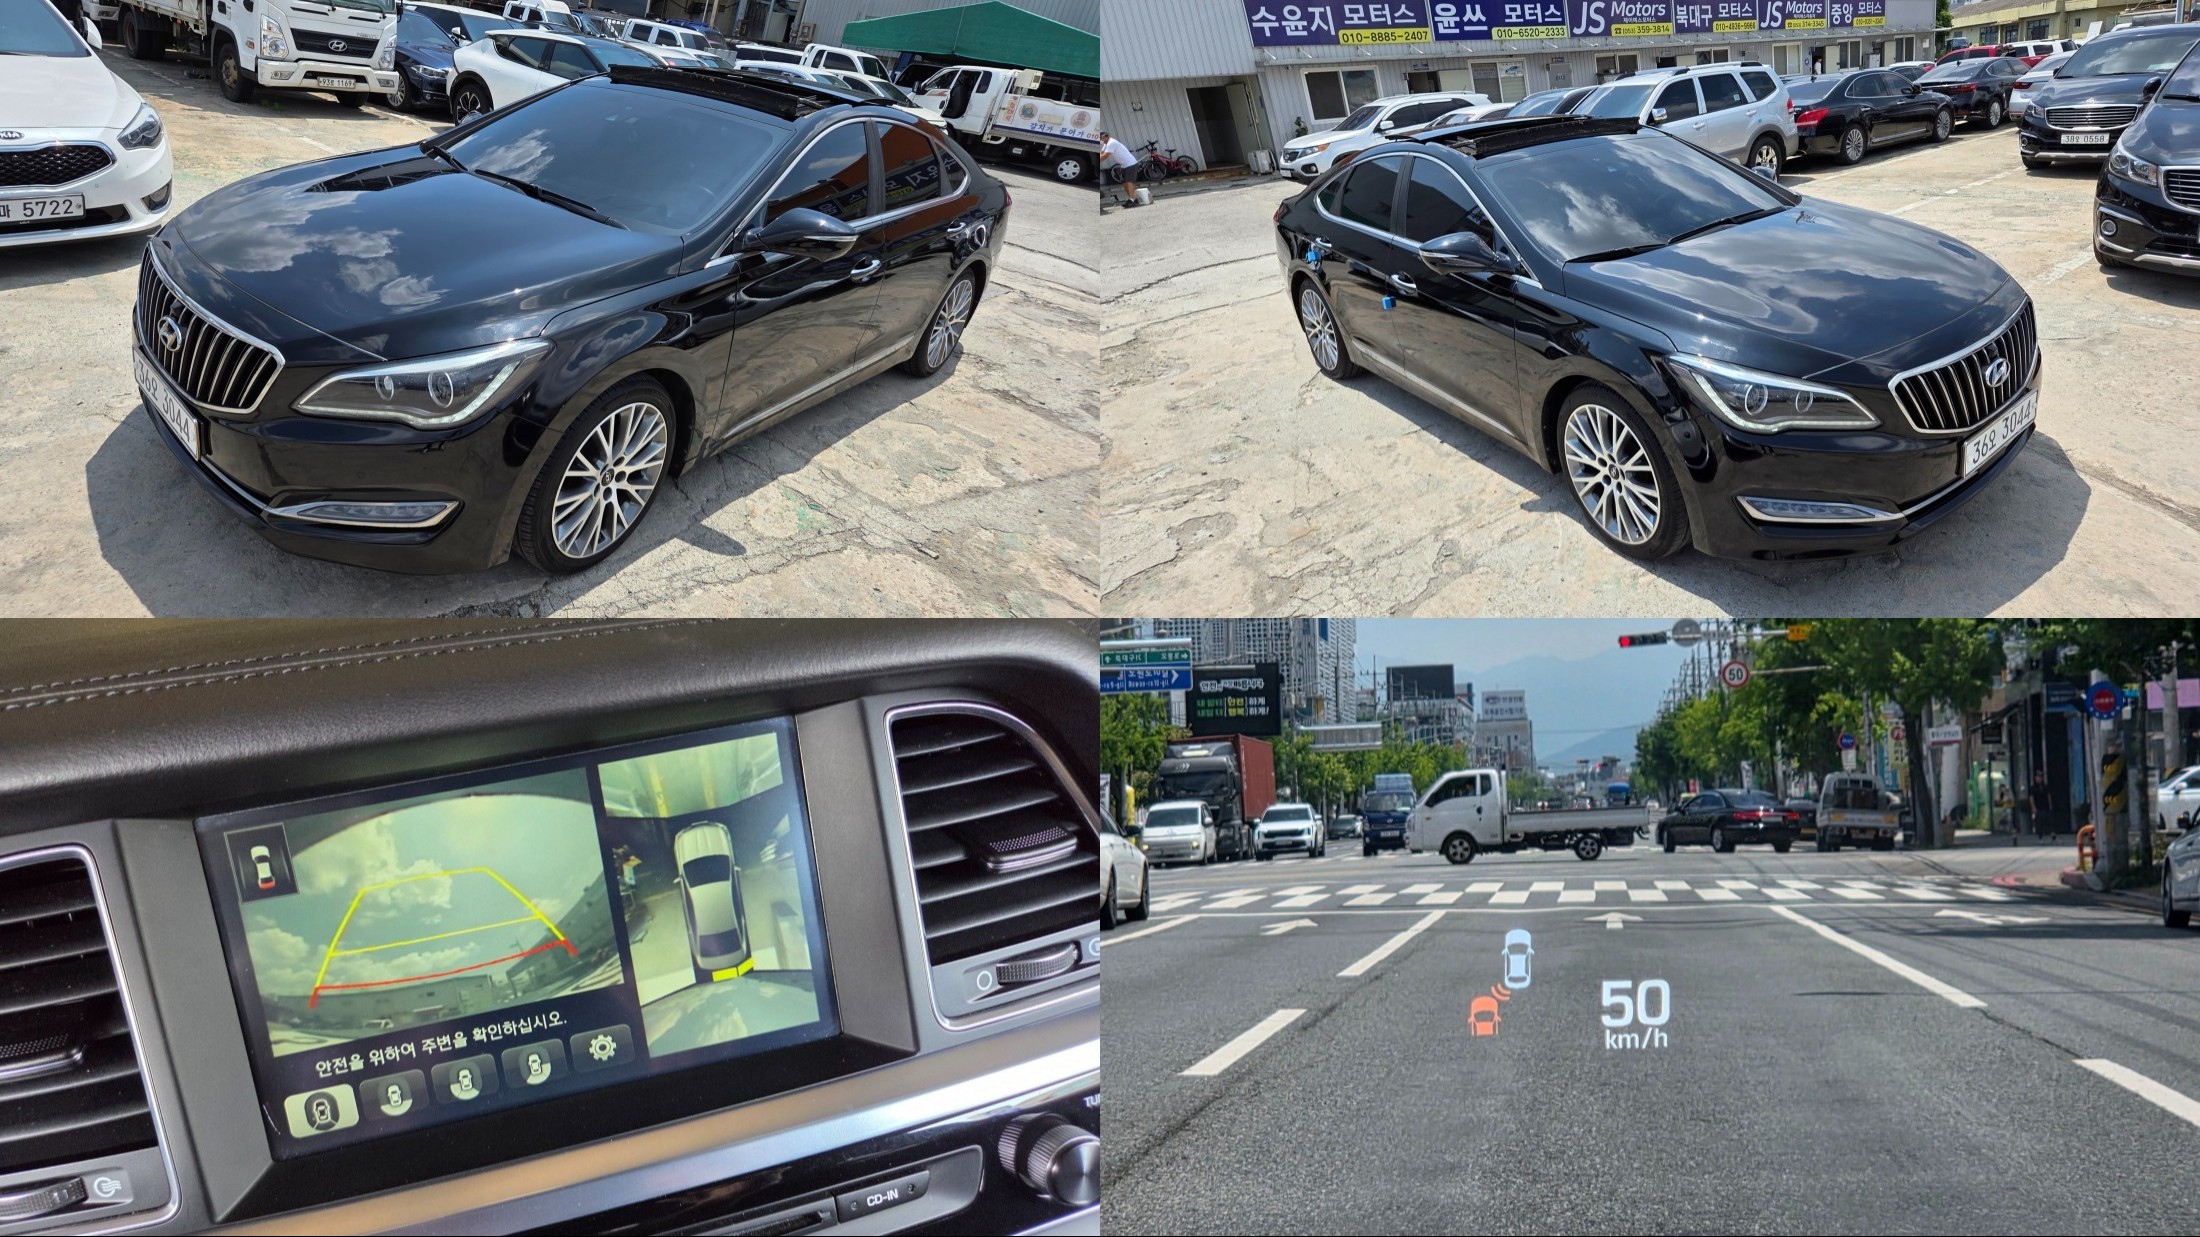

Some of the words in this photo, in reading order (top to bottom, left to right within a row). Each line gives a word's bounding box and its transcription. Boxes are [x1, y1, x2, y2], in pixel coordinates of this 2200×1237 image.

[1252, 5, 1336, 37] 수윤지
[1344, 3, 1417, 25] 모터스
[1434, 3, 1488, 34] 윤쓰
[1504, 3, 1562, 23] 모터스
[1573, 1, 1605, 35] JS
[1611, 1, 1666, 17] Motors
[1676, 4, 1713, 28] 북대구
[1718, 3, 1753, 18] 모터스
[1760, 1, 1783, 28] JS
[1785, 1, 1823, 14] Motors
[1831, 3, 1853, 25] 중앙
[1857, 2, 1882, 14] 모터스
[1342, 31, 1428, 43] 010-8885-2407
[1496, 27, 1565, 39] 010-6520-2333
[1636, 25, 1670, 34] 359-3814
[0, 131, 20, 139] KIA
[23, 199, 74, 218] 5722
[163, 388, 190, 443] 3044
[1972, 429, 1997, 465] 36오
[2002, 400, 2031, 440] 3044
[1728, 668, 1744, 682] 50
[1601, 979, 1670, 1027] 50
[315, 1053, 365, 1078] 안전을
[369, 1041, 416, 1067] 위하여
[421, 1031, 468, 1056] 주변을
[472, 1011, 567, 1044] 확인하십시오.
[1605, 1027, 1668, 1050] km/h
[866, 1188, 899, 1207] CD-IN
